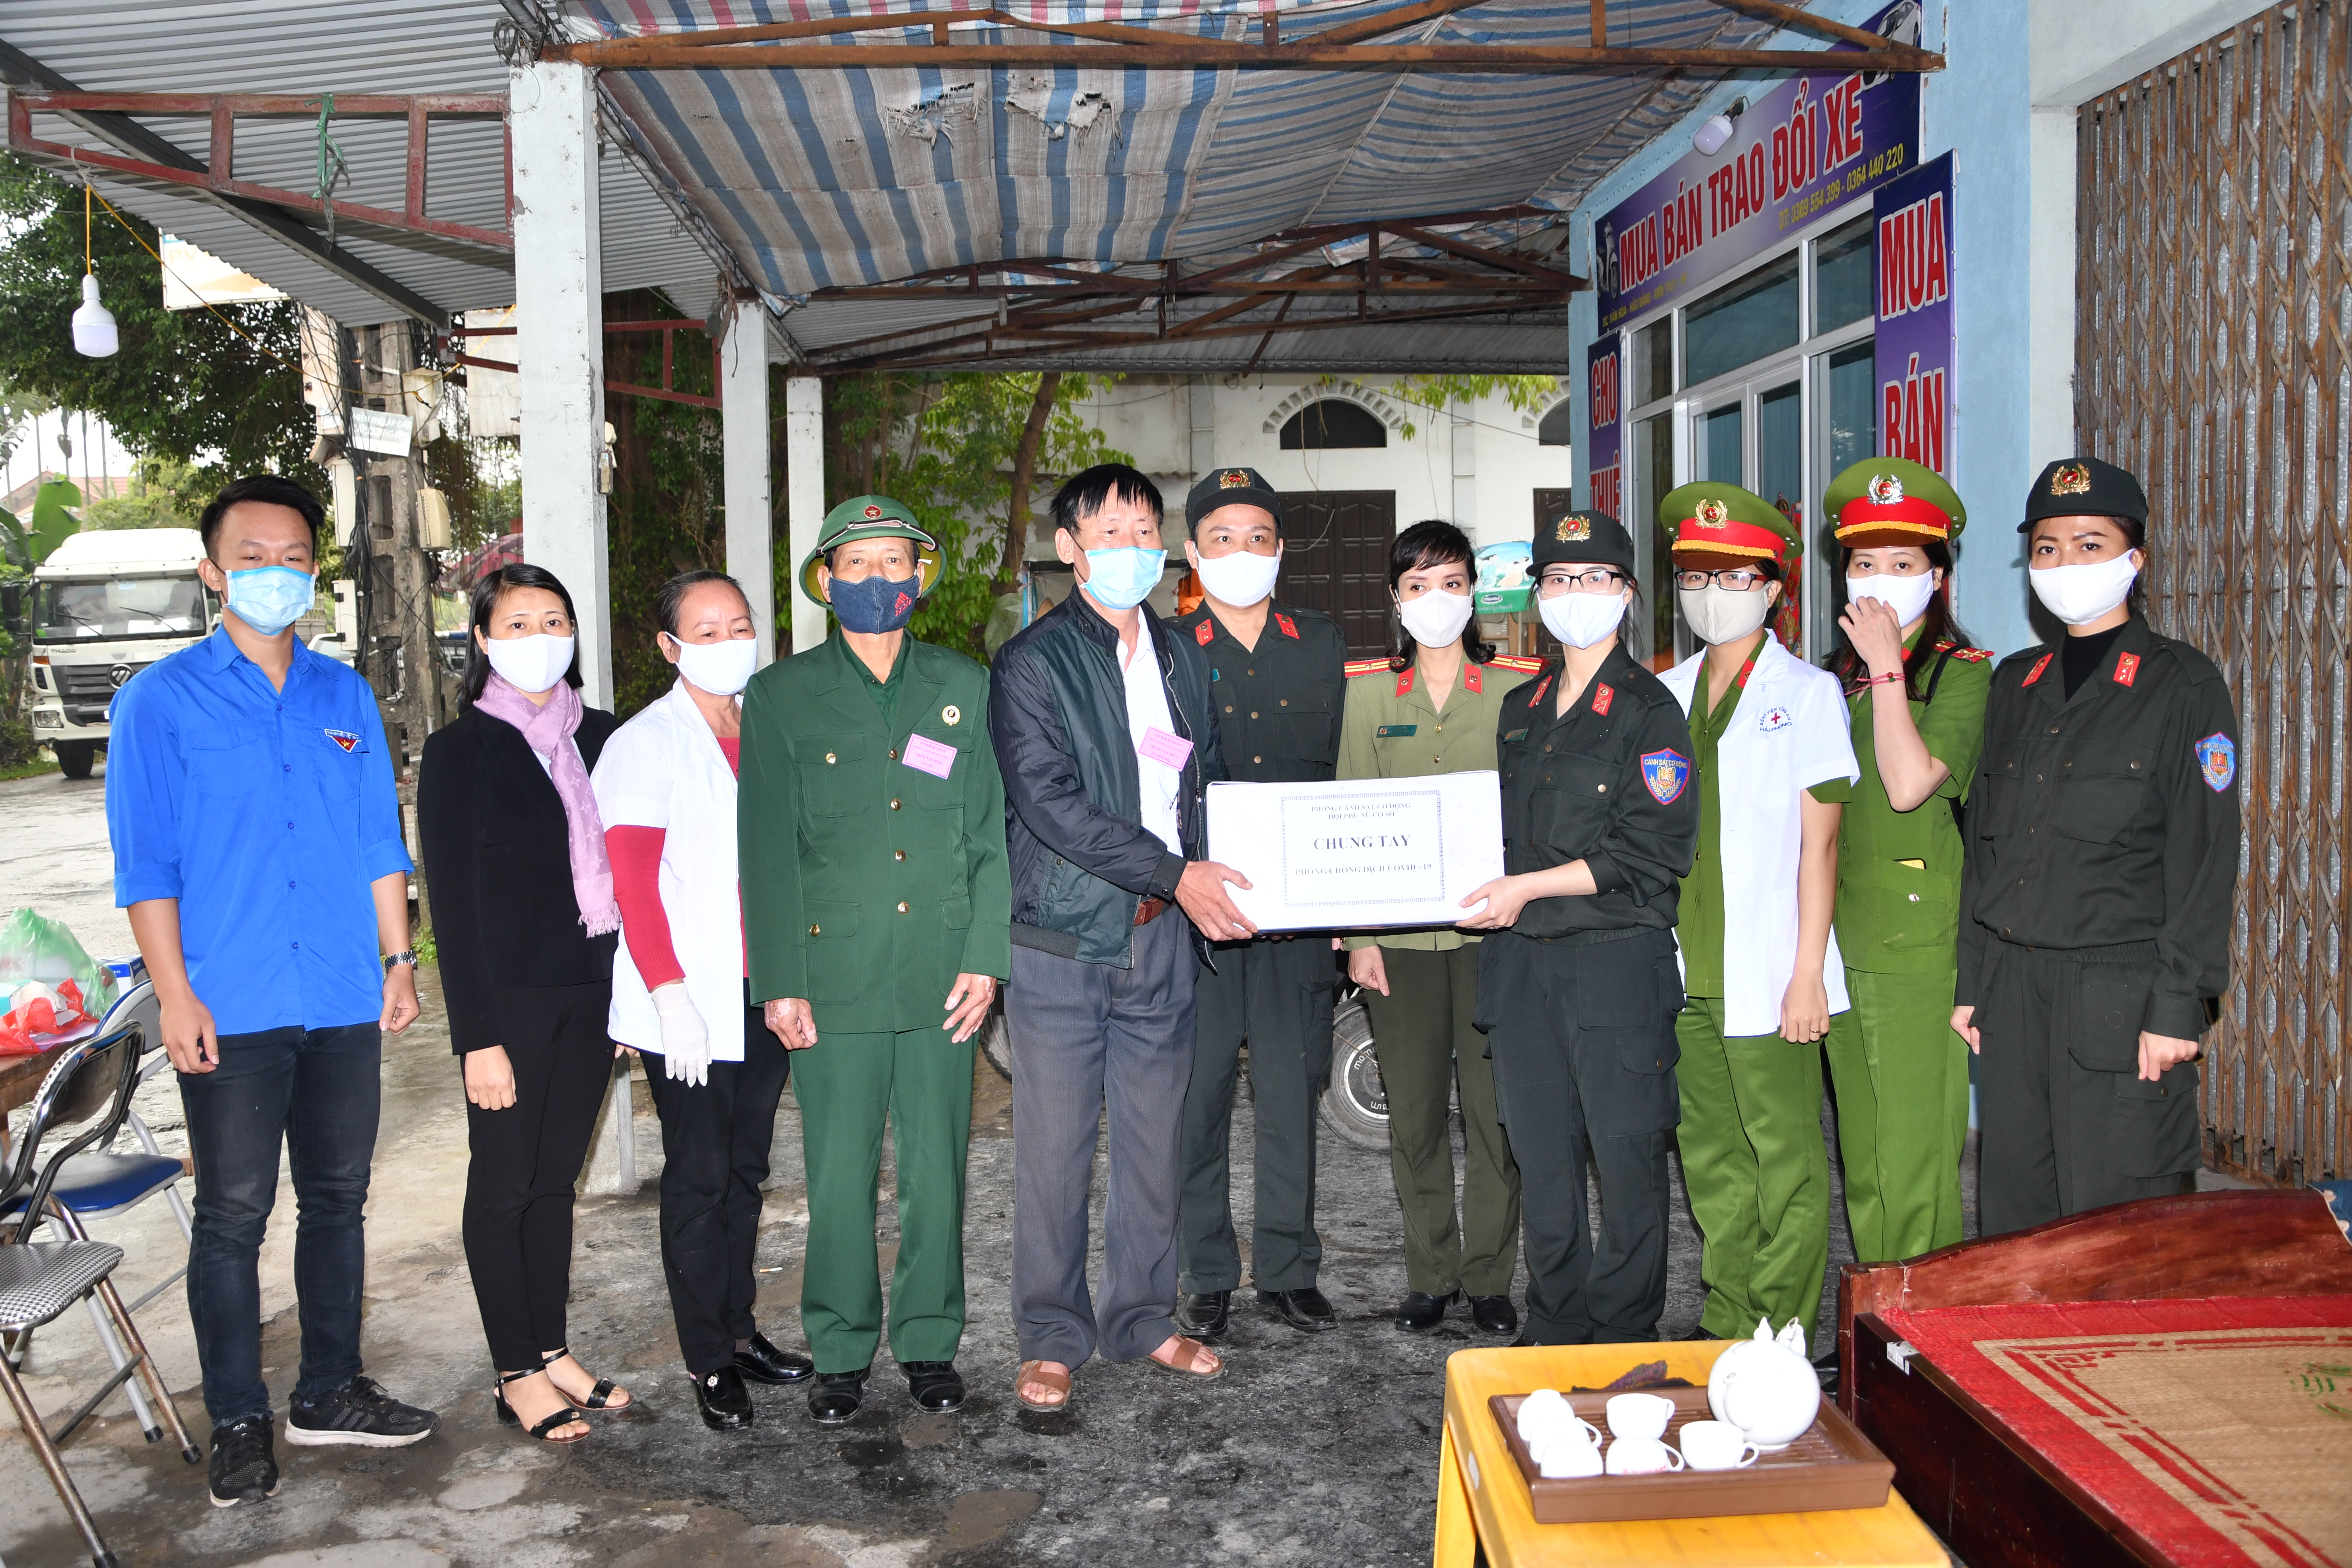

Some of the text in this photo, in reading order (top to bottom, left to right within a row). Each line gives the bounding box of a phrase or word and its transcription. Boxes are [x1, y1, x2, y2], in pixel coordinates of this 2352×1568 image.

[1619, 70, 1862, 295] MUA BÁN TRAO ĐỔI XE
[1791, 197, 1809, 223] 0369
[1810, 188, 1824, 212] 554
[1826, 179, 1840, 204] 399
[1847, 163, 1867, 192] 0364
[1868, 154, 1884, 180] 440
[1886, 143, 1904, 172] 220
[1880, 191, 1948, 322] MUA
[1591, 351, 1617, 430] CHO
[1884, 351, 1944, 476] BÁN
[1314, 835, 1410, 849] CHUNG TAY
[1364, 865, 1385, 874] DỊCH
